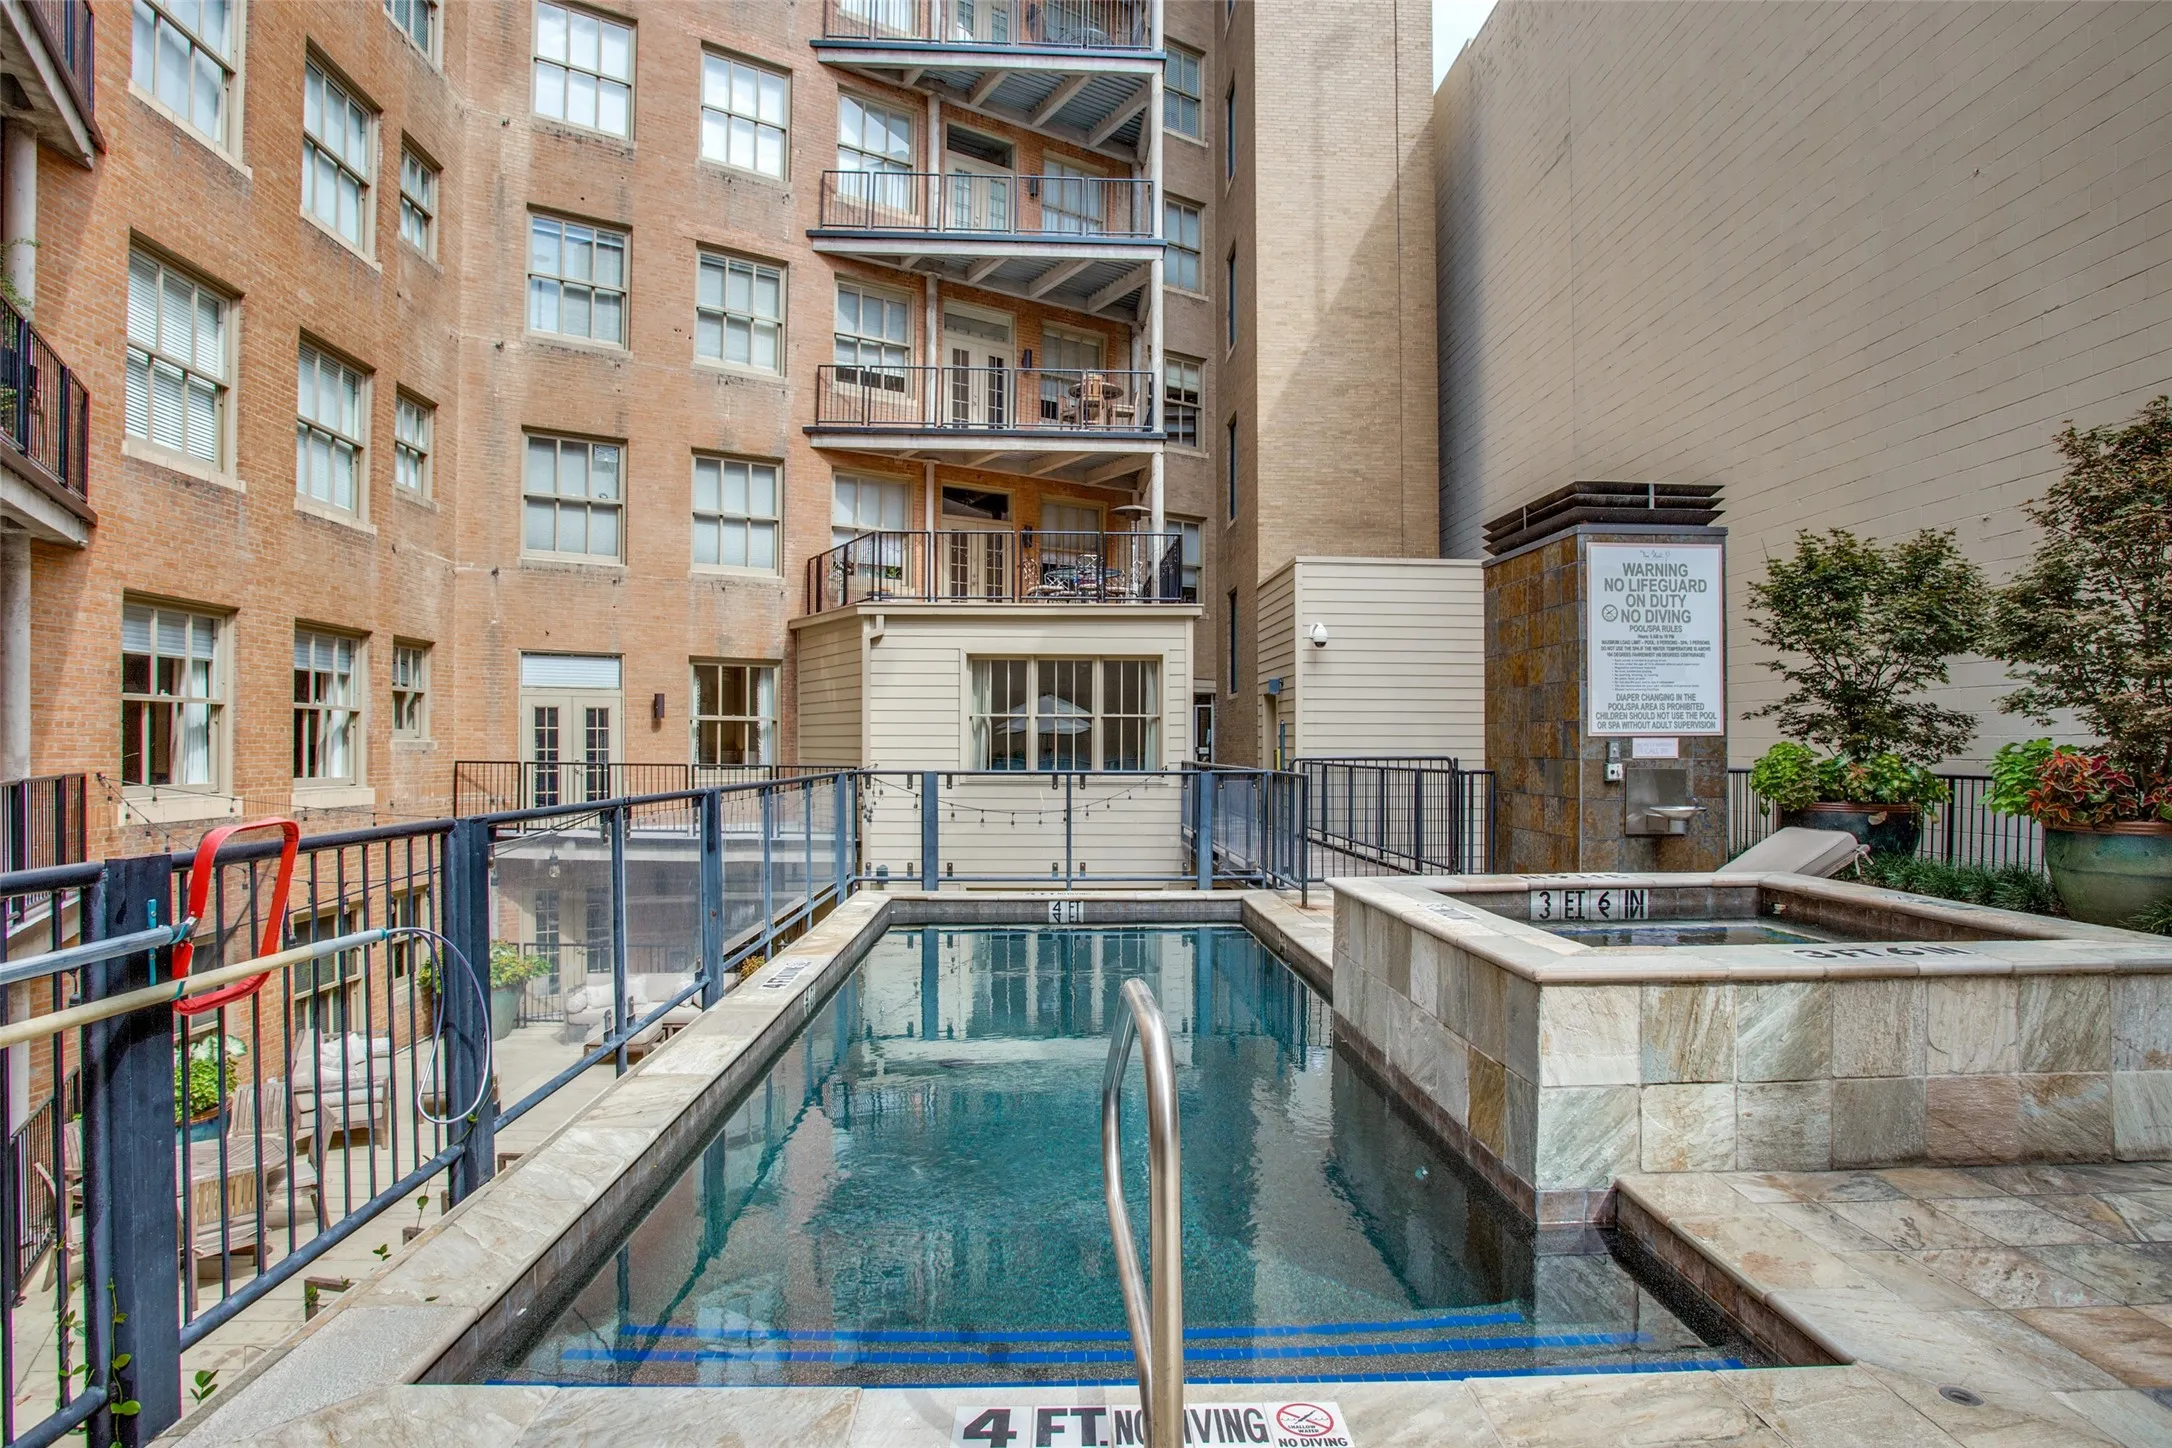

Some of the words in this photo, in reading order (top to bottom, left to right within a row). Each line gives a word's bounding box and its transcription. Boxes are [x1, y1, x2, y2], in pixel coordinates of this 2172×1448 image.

[1622, 563, 1688, 577] WARNING
[1604, 578, 1624, 592] NO
[1628, 578, 1707, 593] LIFEGUARD
[1626, 594, 1645, 607] ON
[1650, 594, 1686, 608] DUTY
[1621, 609, 1641, 623] NO
[1645, 610, 1691, 623] DIVING
[1629, 625, 1660, 633] POOL/SPA
[1662, 625, 1682, 633] RULES
[1616, 693, 1639, 701] DIAPER
[1641, 693, 1674, 701] CHANGING
[1676, 693, 1683, 701] IN
[1684, 693, 1696, 701] THE
[1608, 702, 1640, 710] POOL/SPA
[1640, 702, 1658, 710] AREA
[1660, 702, 1665, 710] IS
[1667, 702, 1704, 710] PROHIBITED
[1596, 712, 1628, 720] CHILDREN
[1630, 712, 1656, 720] SHOULD
[1656, 712, 1670, 720] NOT
[1671, 712, 1685, 720] USE
[1686, 712, 1697, 720] THE
[1699, 712, 1717, 720] POOL
[1597, 721, 1607, 729] OR
[1608, 721, 1620, 729] SPA
[1622, 721, 1650, 729] WITHOUT
[1652, 721, 1672, 729] ADULT
[1674, 721, 1716, 729] SUPERVISION
[1793, 950, 1838, 958] 3
[1886, 948, 1925, 956] 6
[963, 1408, 1017, 1448] 4
[1036, 1407, 1108, 1448] FT.
[1183, 1408, 1270, 1444] IVING
[1278, 1438, 1298, 1448] NO
[1300, 1438, 1348, 1447] DIVING
